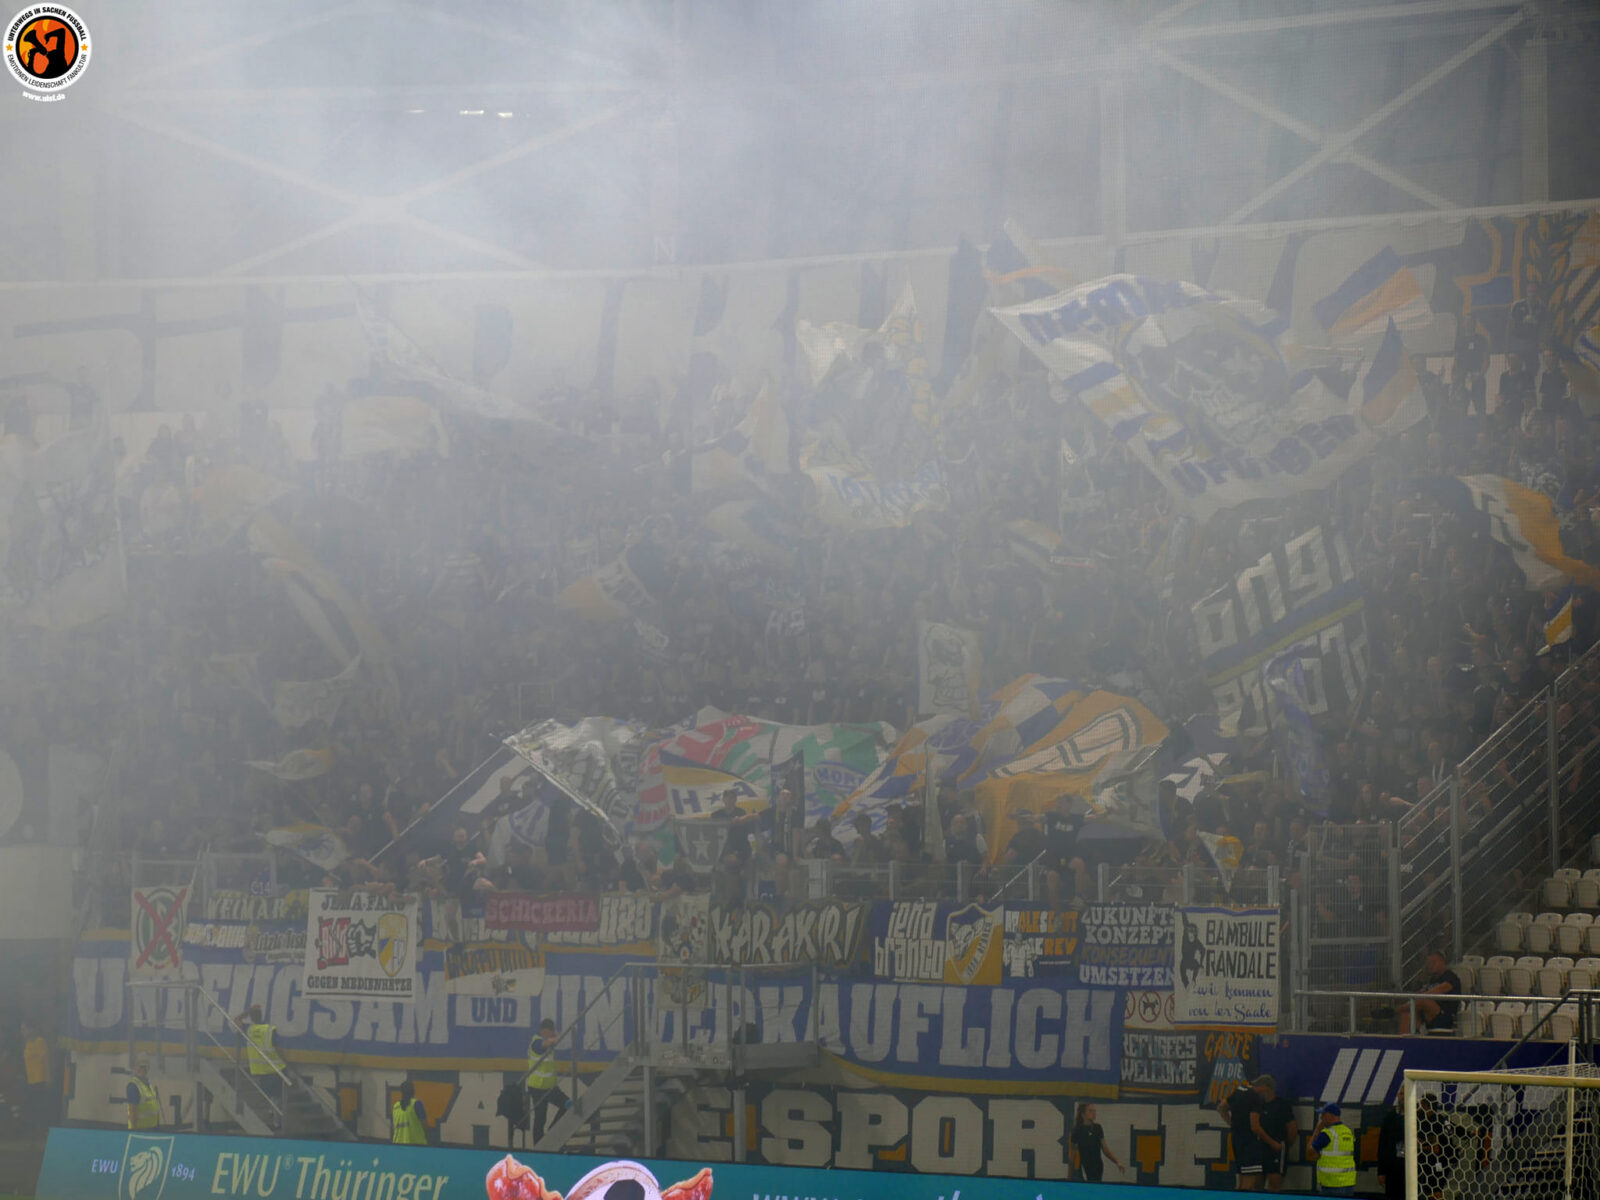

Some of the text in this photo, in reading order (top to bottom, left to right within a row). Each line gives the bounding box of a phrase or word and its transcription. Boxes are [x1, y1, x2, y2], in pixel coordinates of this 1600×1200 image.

[1205, 919, 1277, 948] BAMBULE
[1205, 949, 1277, 979] RANDALE
[307, 975, 339, 990] GEGEN
[471, 997, 519, 1024] UND
[1122, 1033, 1197, 1058] REFUGEES
[1121, 1058, 1197, 1084] WELCOME
[1213, 1063, 1245, 1079] IN DIE
[91, 1158, 196, 1181] EWU 1894
[296, 1154, 450, 1200] Thüringer
